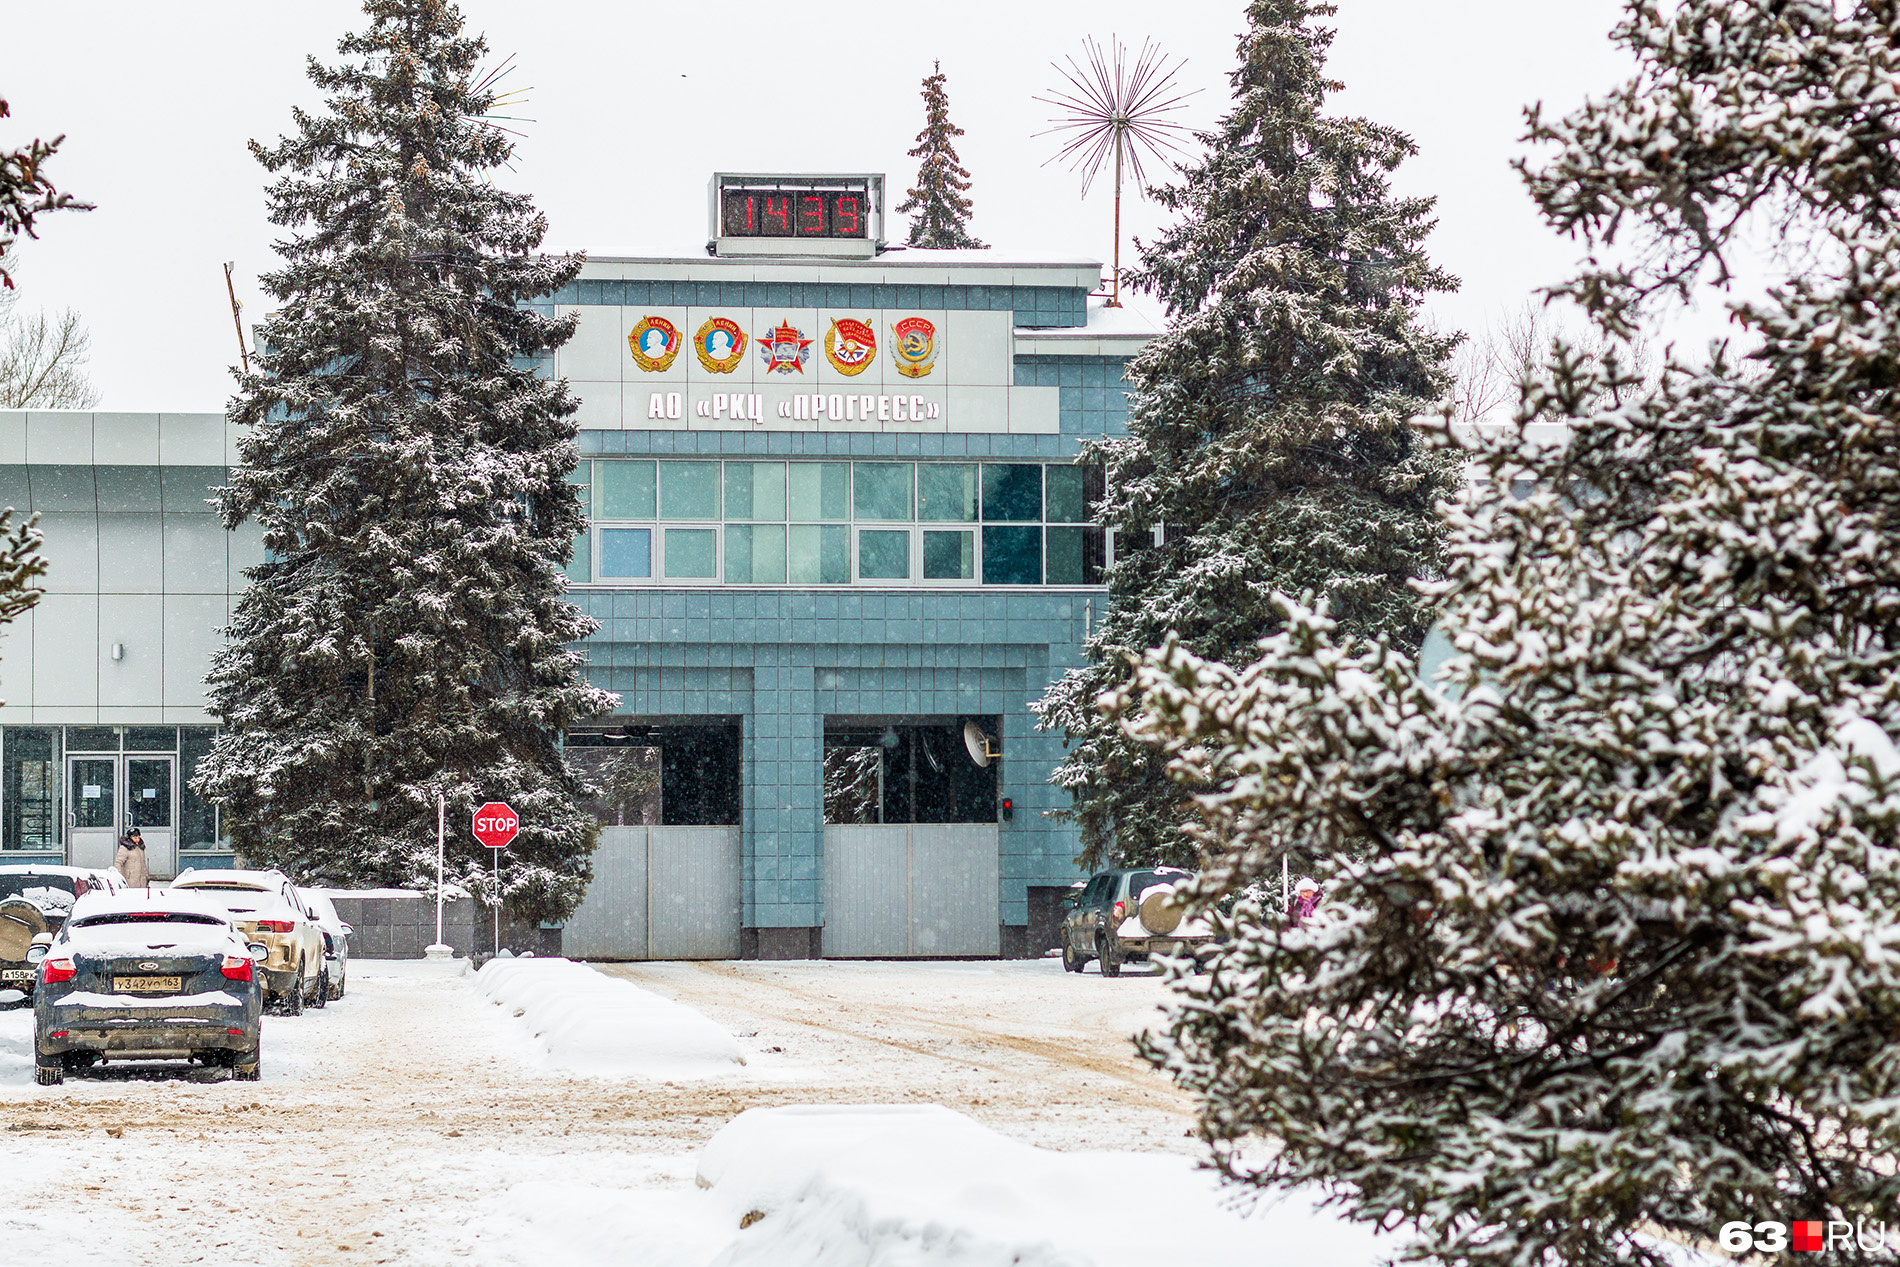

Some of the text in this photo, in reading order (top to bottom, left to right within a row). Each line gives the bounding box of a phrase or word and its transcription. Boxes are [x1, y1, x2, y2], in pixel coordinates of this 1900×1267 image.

[901, 320, 931, 331] СССР
[648, 392, 940, 424] АО «РКЦ «ПРОГРЕСС»
[477, 817, 516, 832] STOP
